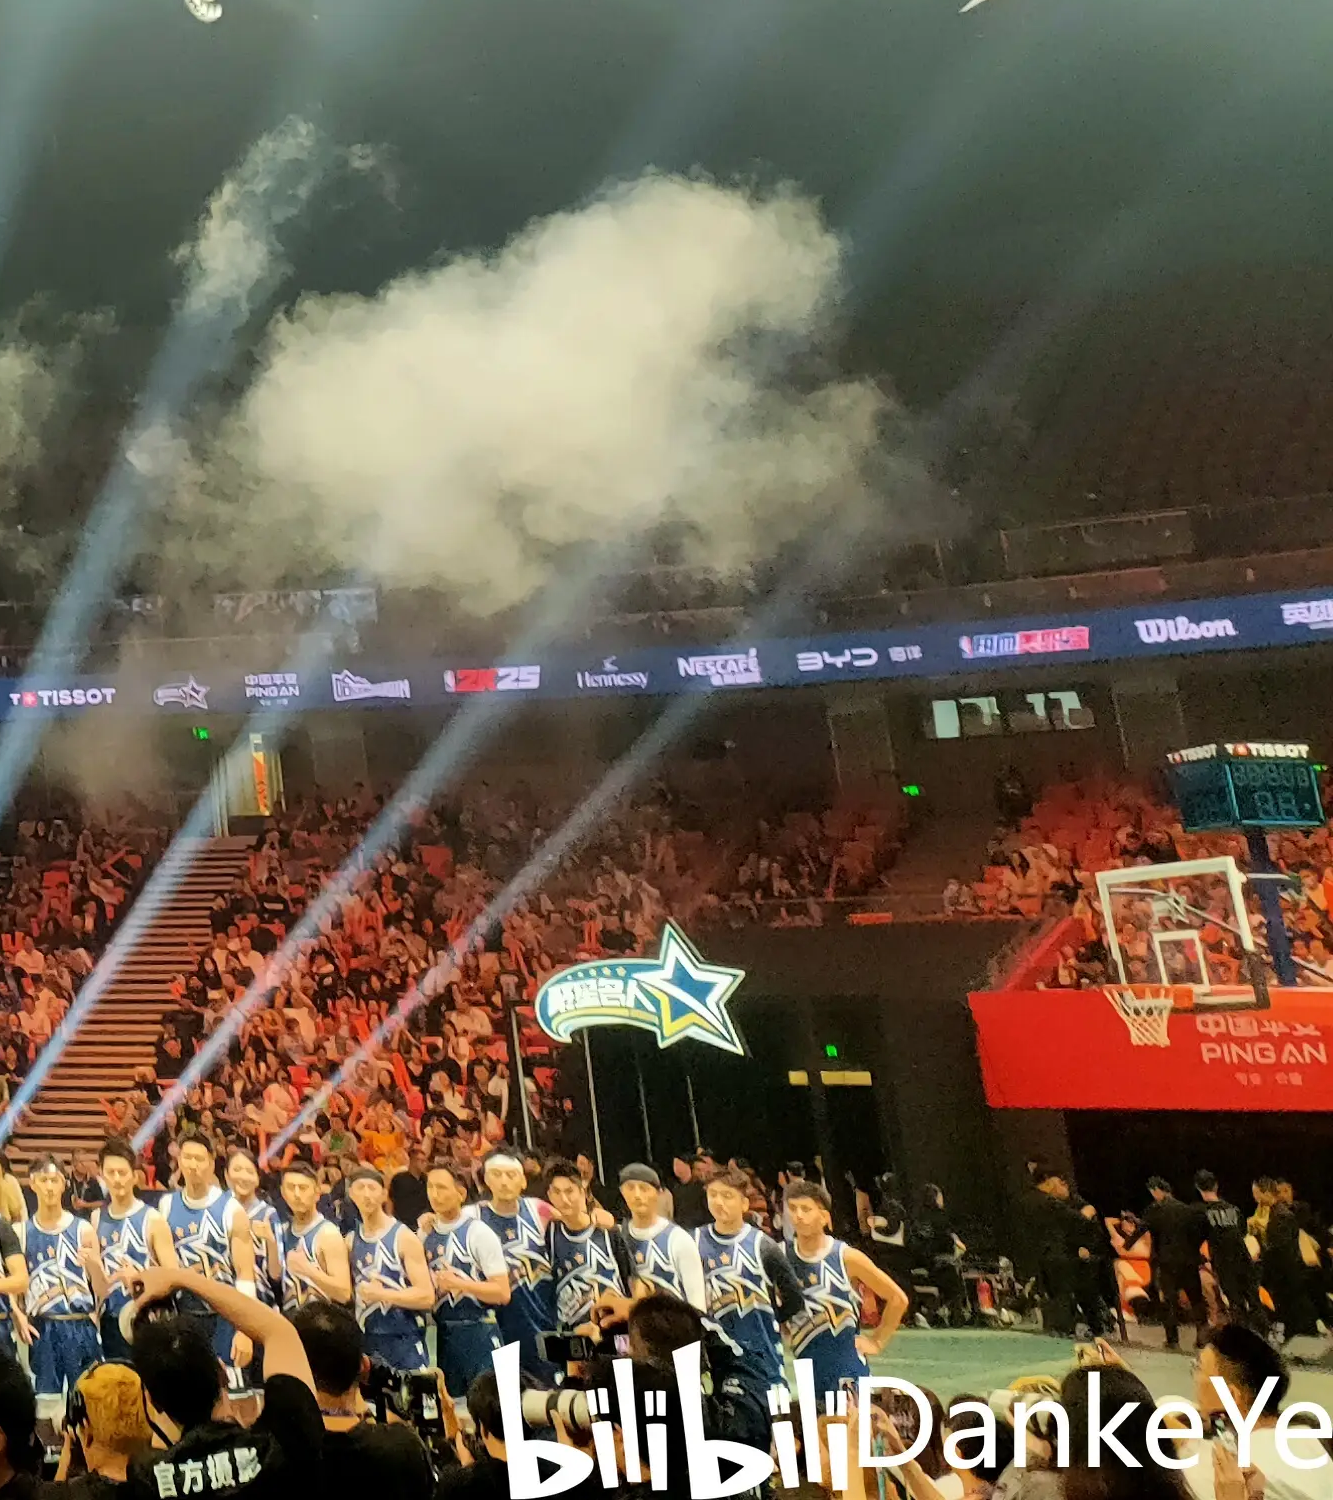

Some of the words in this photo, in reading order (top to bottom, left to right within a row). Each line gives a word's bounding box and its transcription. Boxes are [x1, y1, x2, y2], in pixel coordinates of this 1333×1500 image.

[1134, 615, 1238, 644] Wilson
[796, 647, 879, 672] BYD
[576, 670, 649, 689] Hennessy
[37, 687, 116, 706] TISSOT
